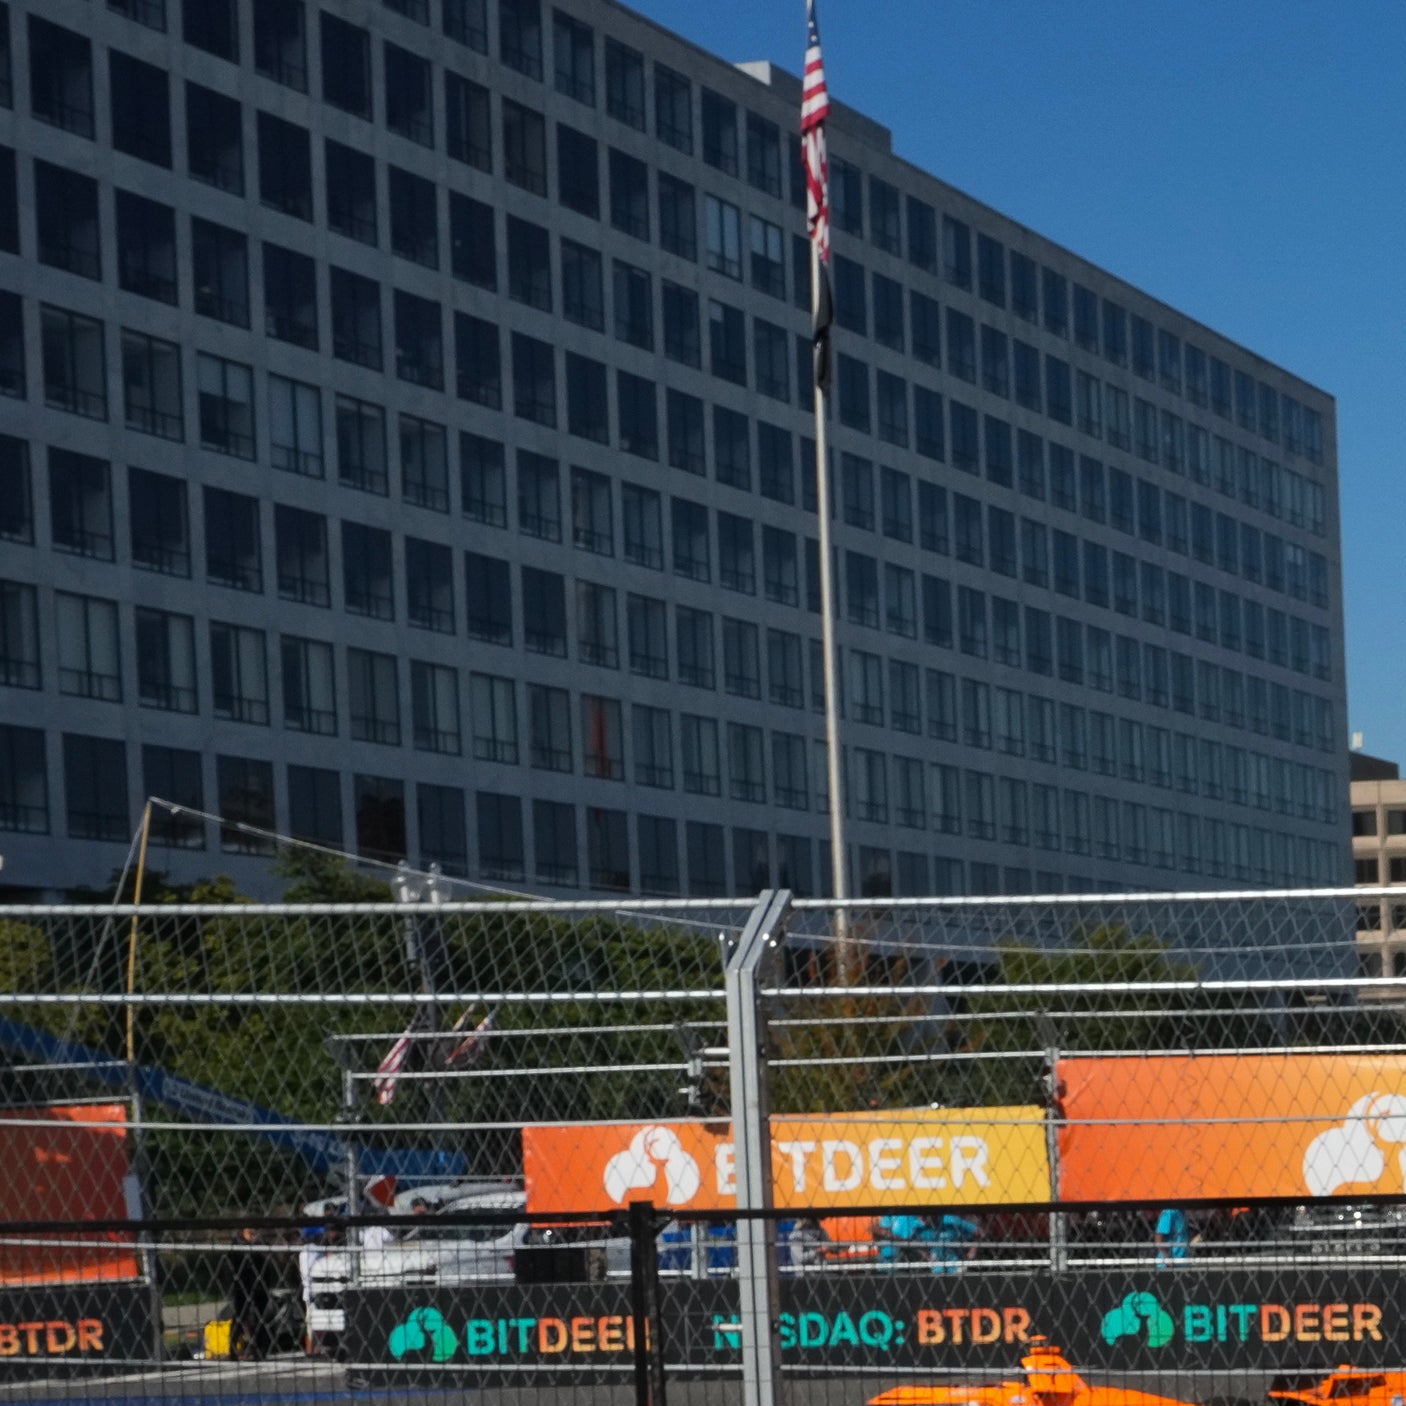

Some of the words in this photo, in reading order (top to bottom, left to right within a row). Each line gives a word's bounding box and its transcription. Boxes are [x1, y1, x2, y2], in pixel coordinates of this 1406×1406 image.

[715, 1135, 991, 1195] BTDEER
[0, 1318, 104, 1355] BTDR
[713, 1309, 905, 1350] NSDAQ:
[917, 1307, 1031, 1345] BTDR
[1184, 1303, 1383, 1342] BITDEER
